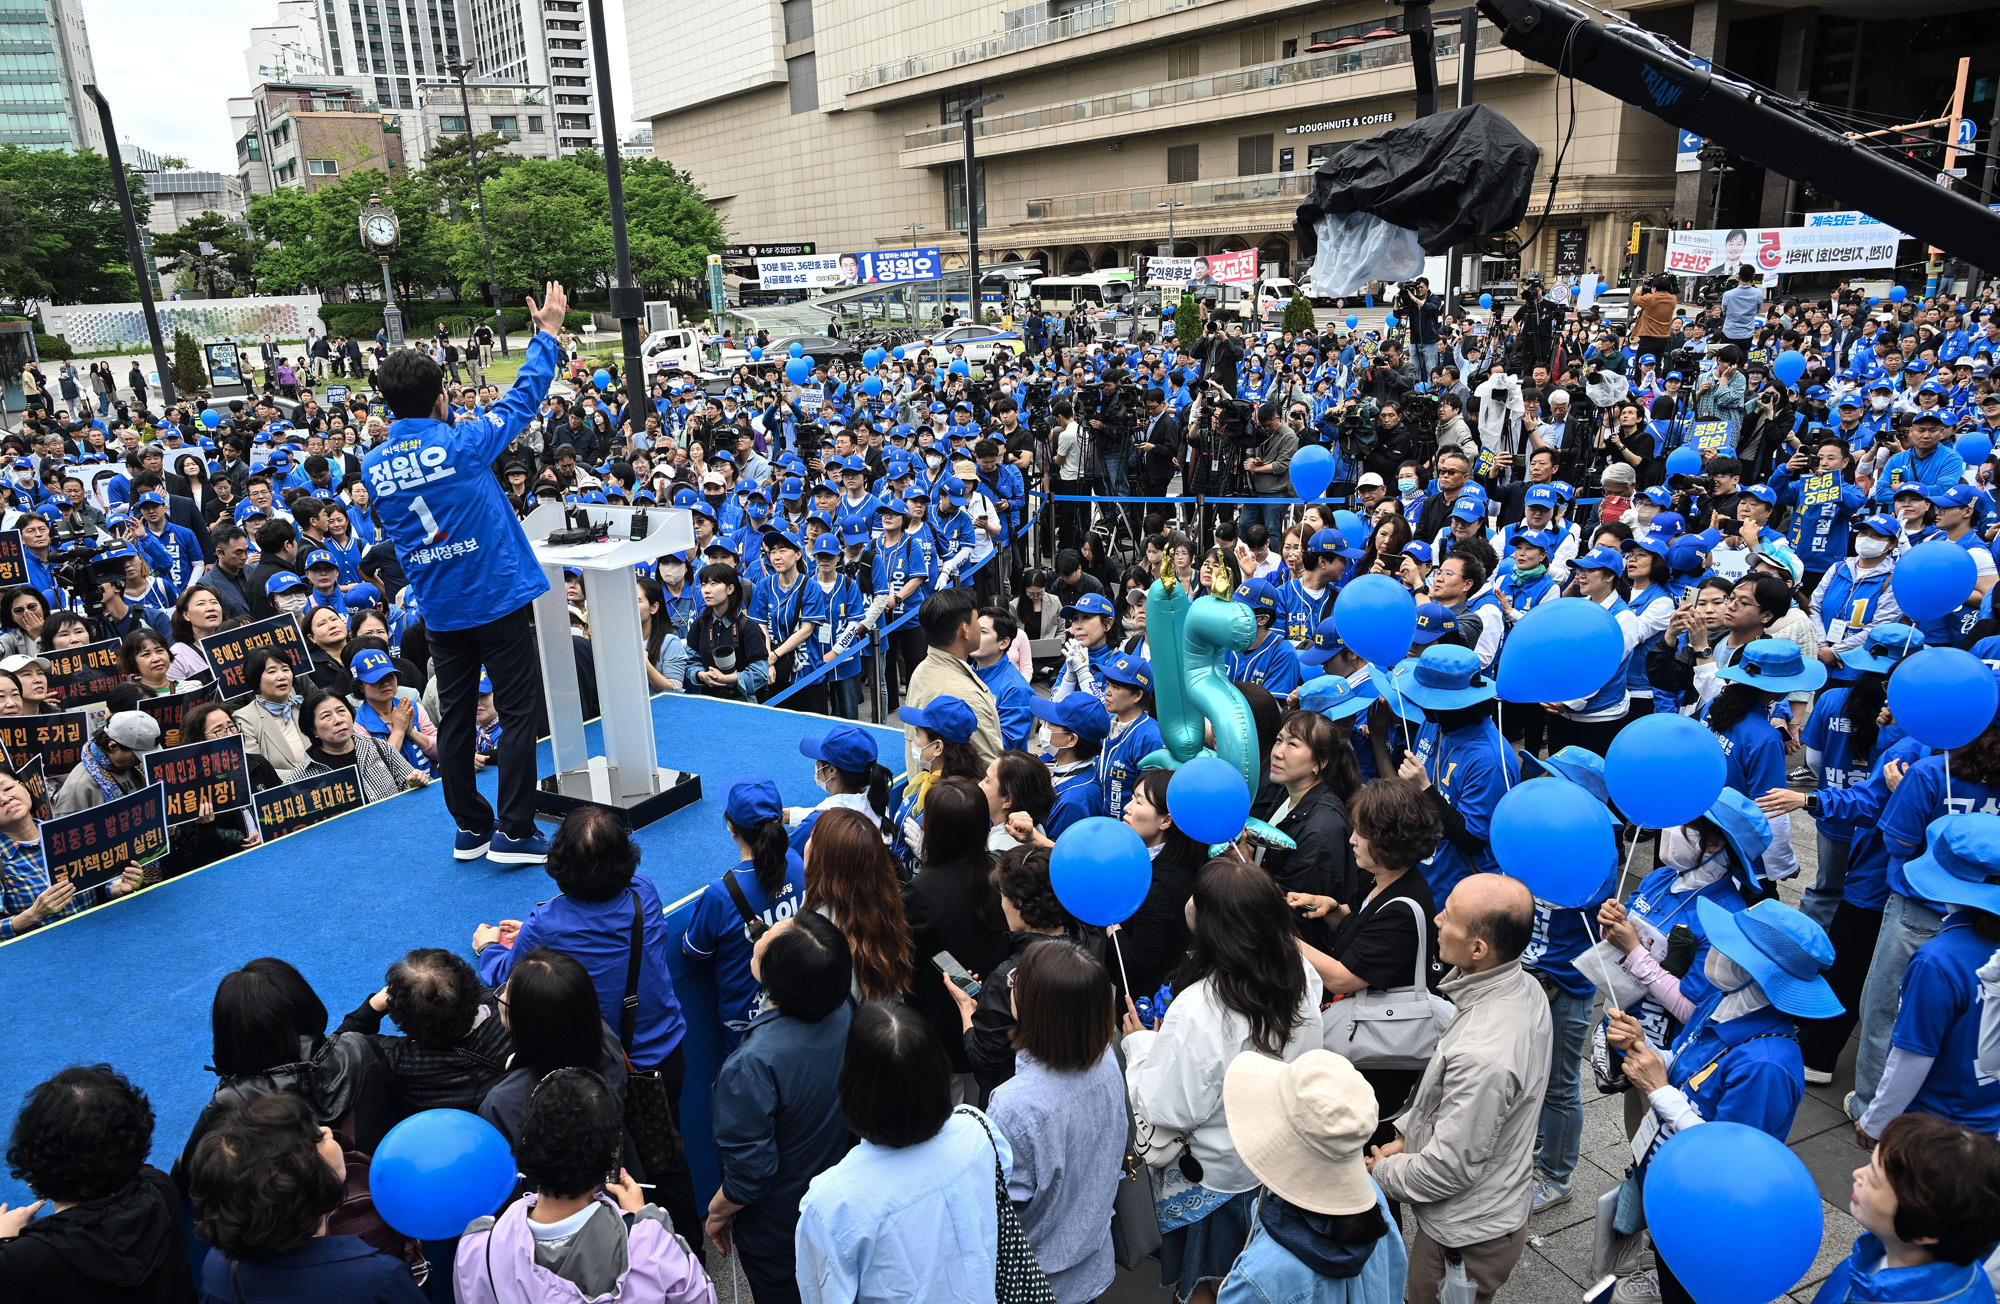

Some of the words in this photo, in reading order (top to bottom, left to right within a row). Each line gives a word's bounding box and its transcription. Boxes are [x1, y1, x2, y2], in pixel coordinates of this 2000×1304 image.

[1300, 118, 1350, 134] DOUGHNUTS
[1352, 118, 1359, 126] &
[1362, 112, 1393, 125] COFFEE
[1810, 214, 1856, 227] 계속되는
[761, 262, 779, 272] 30분
[780, 262, 796, 272] 통근,
[798, 261, 820, 270] 36만호
[822, 260, 836, 269] 공급
[860, 253, 878, 283] 1
[876, 258, 934, 281] 정원오
[1212, 254, 1254, 282] 정교진
[764, 275, 792, 284] AI글로벌
[793, 274, 807, 282] 수도
[1748, 350, 1767, 360] 정원오
[1694, 421, 1728, 437] 정원오
[400, 440, 422, 451] 착착!
[1698, 434, 1727, 449] 압승!
[369, 446, 456, 497] 정원오
[1804, 472, 1833, 492] 압승!
[1805, 486, 1840, 505] 정원오
[1968, 496, 1978, 508] 1
[408, 495, 449, 545] 1
[1676, 521, 1682, 530] 1
[375, 528, 382, 540] 1
[854, 524, 859, 532] 1
[952, 530, 958, 539] 1
[169, 533, 176, 543] 1
[822, 540, 826, 548] 1
[312, 553, 330, 562] 1-나
[409, 538, 479, 565] 서울시장후보
[896, 558, 903, 569] 1
[839, 603, 845, 617] 1
[1525, 597, 1532, 610] 1
[1288, 612, 1306, 622] 1-다
[1848, 598, 1869, 628] 1
[212, 642, 244, 666] 장애인
[274, 624, 298, 644] 확대
[50, 656, 82, 676] 서울의
[87, 648, 118, 668] 미래는
[363, 653, 388, 670] 1-나
[69, 682, 87, 697] 사는
[1336, 684, 1344, 694] 1
[36, 723, 80, 744] 주거권
[50, 750, 80, 765] 서울!
[153, 758, 196, 784] 장애인과
[200, 749, 240, 777] 함께하는
[1110, 767, 1127, 780] 1-다
[1442, 762, 1457, 787] 1
[167, 781, 236, 816] 서울시장!
[262, 793, 306, 825] 자립지원
[310, 782, 356, 811] 확대하는
[53, 822, 97, 855] 최중증
[104, 799, 156, 838] 발달장애
[54, 841, 129, 886] 국가책임제
[133, 827, 163, 857] 실현!
[1688, 1062, 1719, 1092] 1
